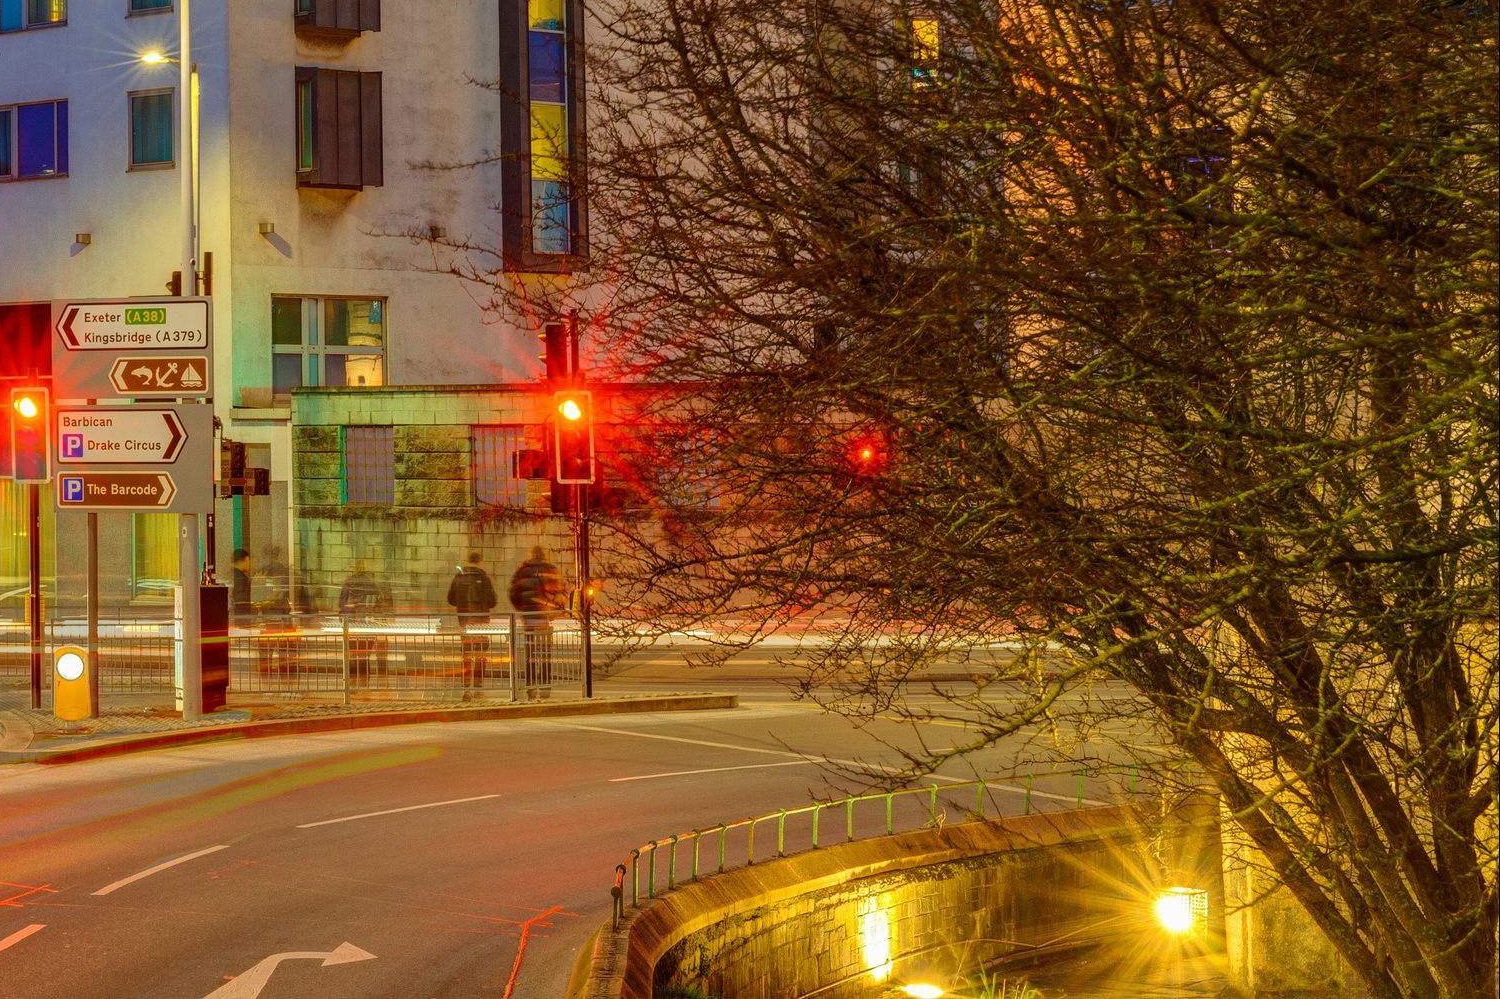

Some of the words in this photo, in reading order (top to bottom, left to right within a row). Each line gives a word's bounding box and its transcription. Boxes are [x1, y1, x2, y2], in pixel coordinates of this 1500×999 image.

[84, 312, 121, 323] Exeter
[126, 310, 165, 323] (A38)
[84, 333, 152, 345] Kingsbridge
[155, 331, 202, 343] (A379)
[63, 416, 112, 427] Barbican
[67, 436, 81, 456] P
[87, 440, 120, 451] Drake
[125, 440, 161, 451] Circus
[67, 479, 81, 500] P
[87, 484, 107, 495] The
[111, 484, 157, 495] Barcode
